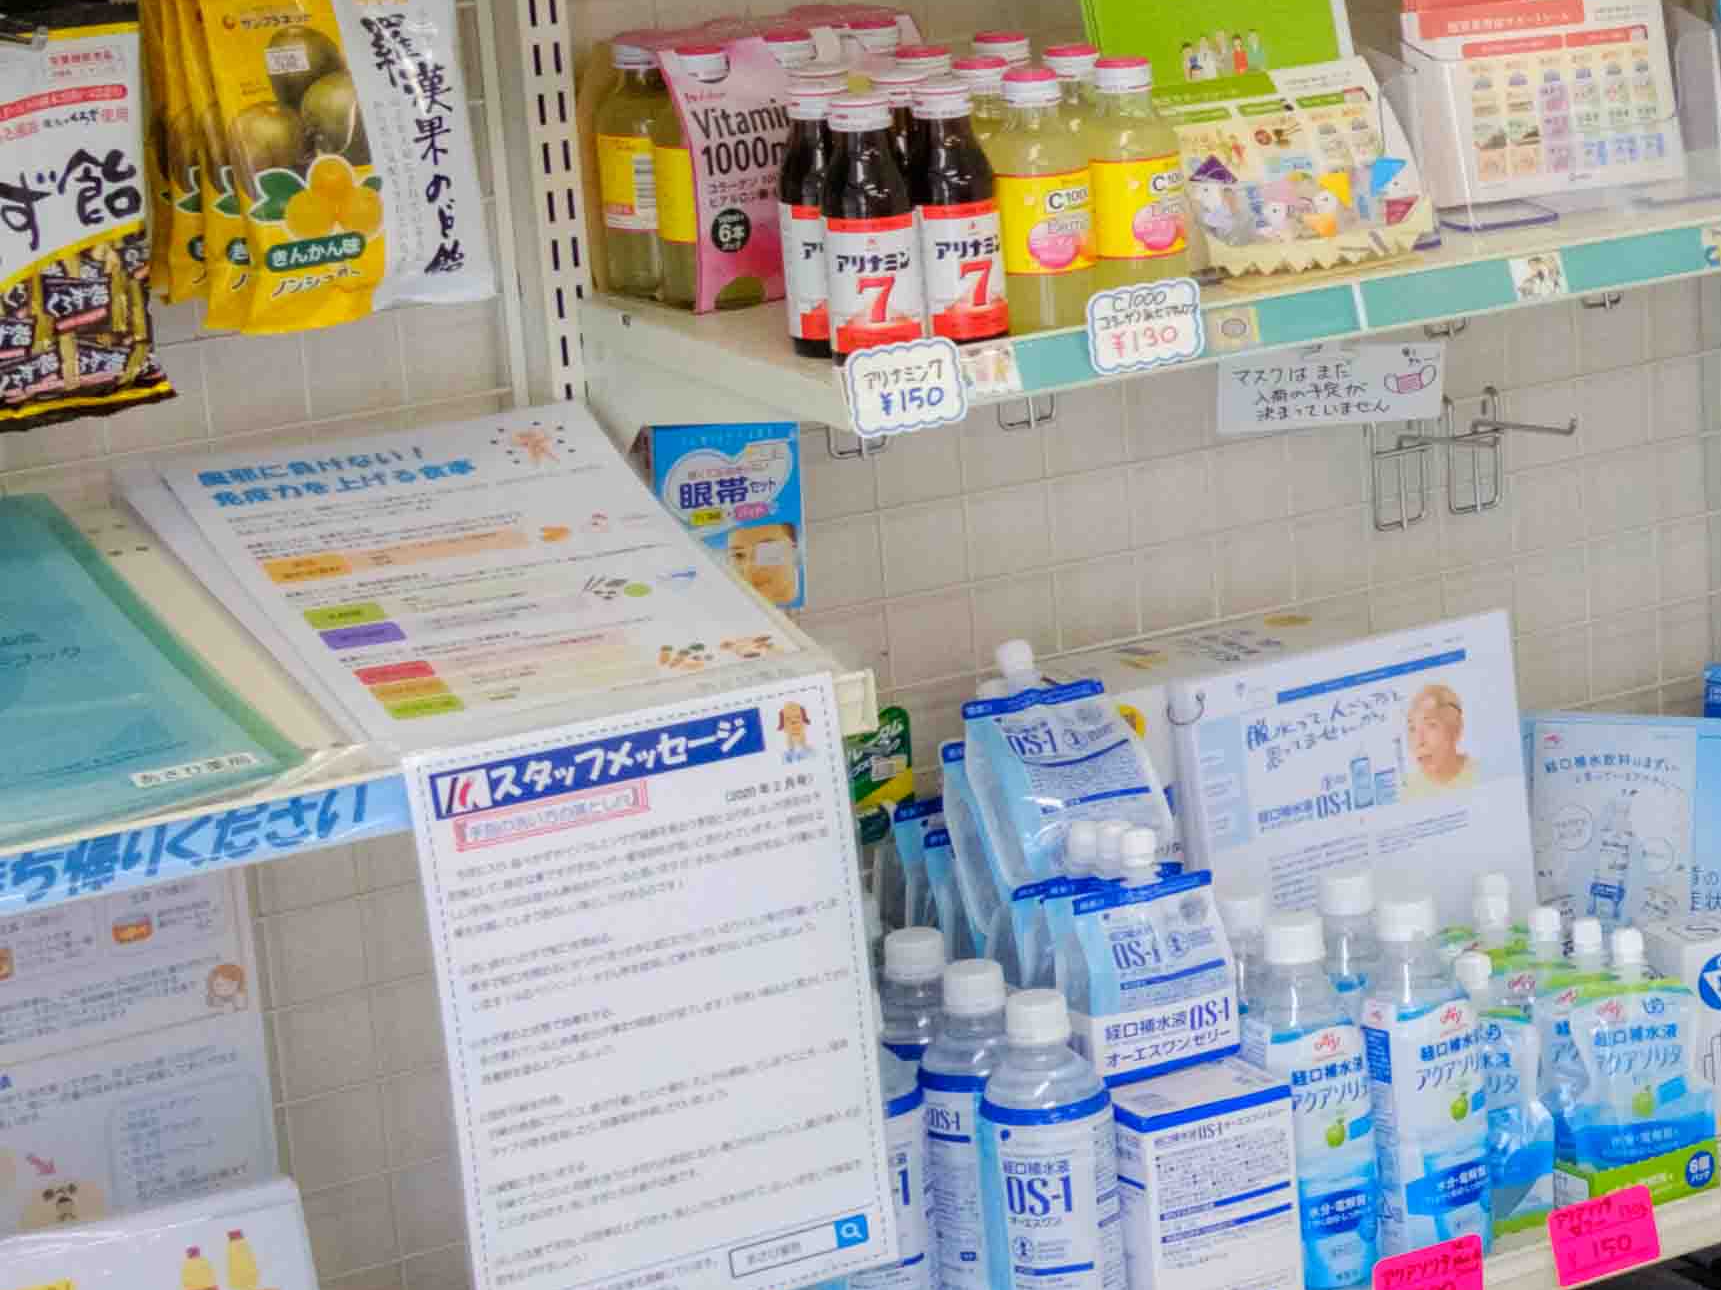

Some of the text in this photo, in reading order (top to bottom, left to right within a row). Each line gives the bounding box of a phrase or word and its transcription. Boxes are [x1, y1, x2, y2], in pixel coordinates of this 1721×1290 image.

[834, 252, 911, 273] アリナミン
[855, 275, 895, 325] 7
[958, 260, 993, 308] 7
[1111, 322, 1179, 358] ¥130
[1232, 360, 1352, 387] マスクは まだ
[879, 386, 945, 418] ¥150
[678, 475, 749, 510] 眼帯
[490, 719, 747, 807] スタッフメッセージ
[1188, 995, 1232, 1032] OS-1
[1595, 1047, 1683, 1076] アクアソリタ
[1002, 1157, 1071, 1177] 経口補水液
[1005, 1174, 1075, 1218] OS-1
